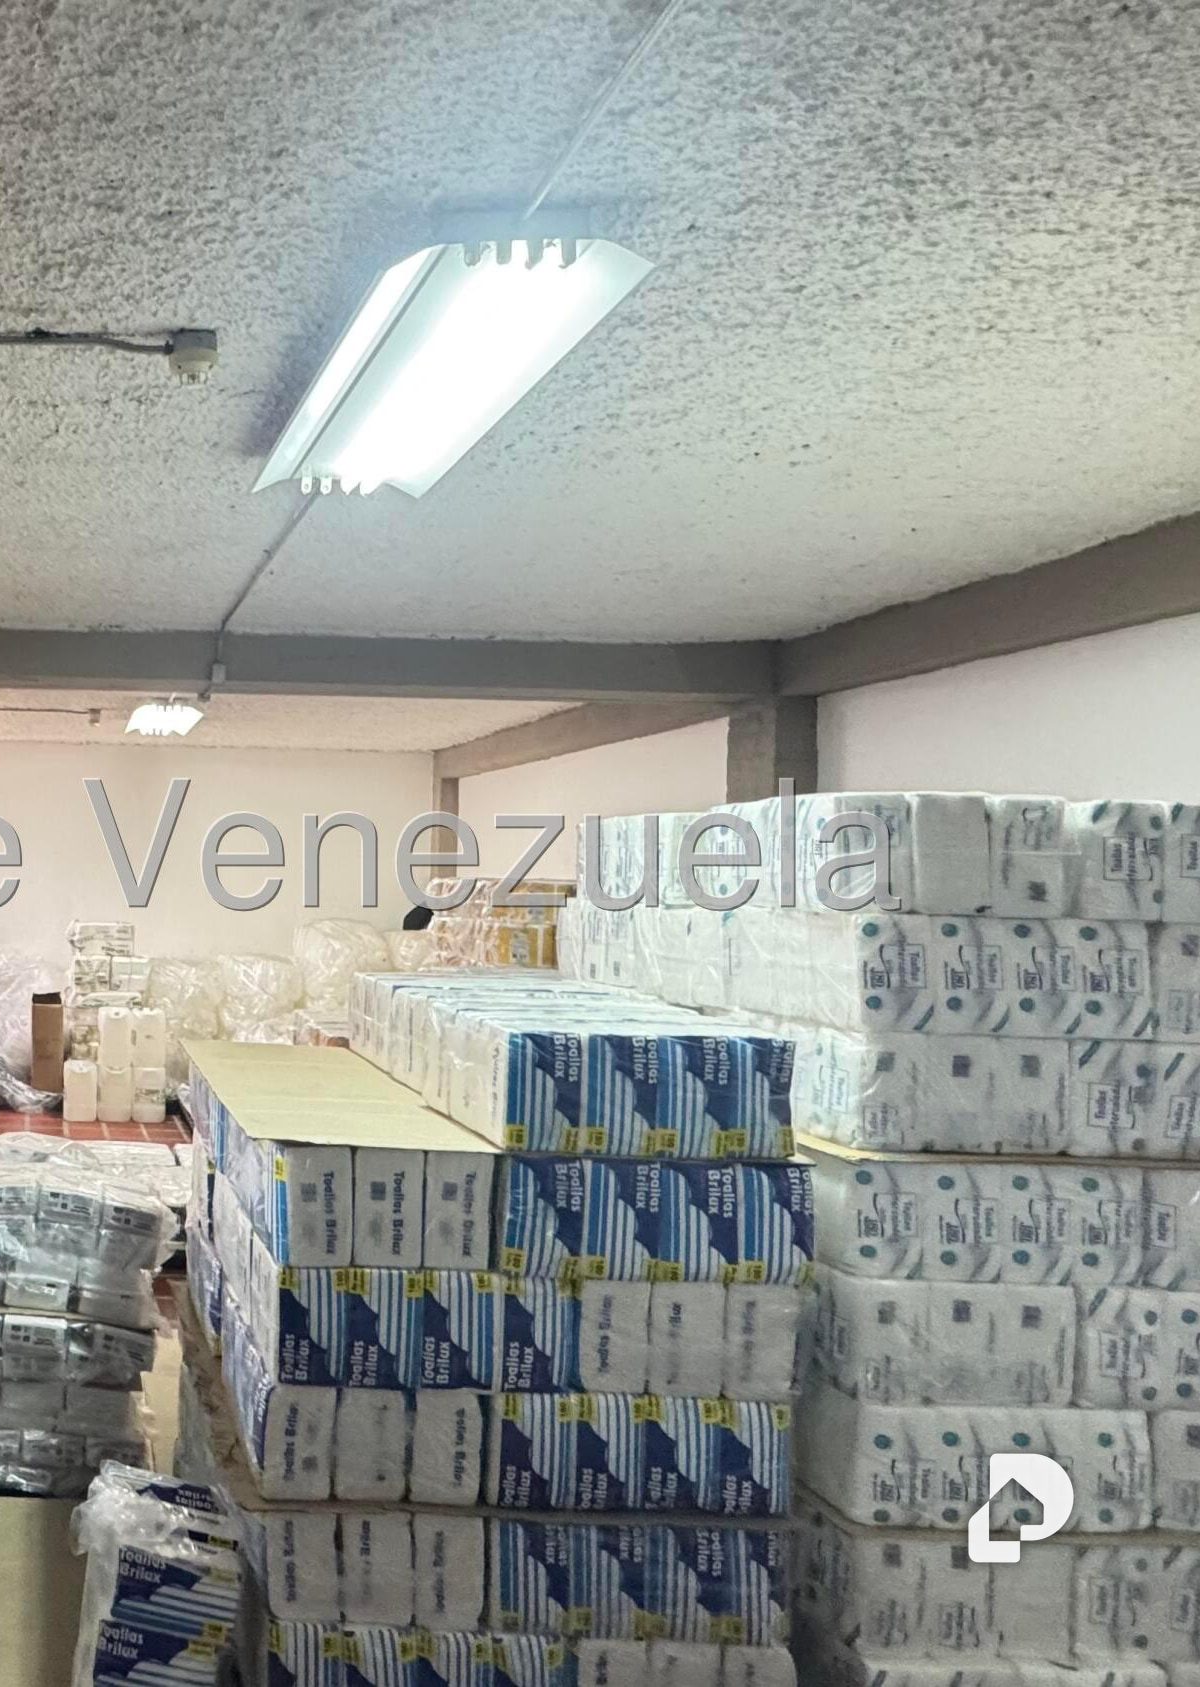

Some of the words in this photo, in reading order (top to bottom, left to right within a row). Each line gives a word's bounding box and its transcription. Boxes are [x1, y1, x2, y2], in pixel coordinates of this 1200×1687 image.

[553, 1034, 566, 1079] Brilux
[567, 1031, 580, 1083] Toallas
[632, 1036, 645, 1081] Brilux
[645, 1035, 659, 1085] Toallas
[702, 1038, 717, 1081] Brilux
[718, 1036, 732, 1086] Toallas
[323, 1170, 335, 1214] Toallas
[393, 1170, 405, 1214] Toallas
[555, 1163, 568, 1209] Brilux
[569, 1160, 583, 1212] Toallas
[637, 1164, 649, 1209] Brilux
[650, 1161, 661, 1213] Toallas
[707, 1169, 720, 1215] Brilux
[721, 1167, 734, 1218] Toallas
[787, 1167, 801, 1212] Brilux
[325, 1219, 337, 1254] Brilux
[392, 1219, 404, 1255] Brilux
[281, 1333, 295, 1381] Toallas
[295, 1339, 310, 1380] Brilux
[350, 1340, 364, 1386] Toallas
[363, 1345, 378, 1386] Brilux
[422, 1336, 436, 1384] Toallas
[436, 1341, 450, 1384] Brilux
[505, 1341, 519, 1390] Toallas
[518, 1346, 534, 1388] Brilux
[175, 1495, 213, 1510] oallas
[502, 1465, 516, 1507] oallas
[580, 1468, 593, 1509] oallas
[645, 1467, 662, 1509] Tallas
[722, 1475, 737, 1515] oallas
[738, 1481, 752, 1514] rilux
[119, 1562, 161, 1583] Brilux
[120, 1547, 167, 1570] Toallas
[711, 1531, 724, 1577] oallas
[97, 1636, 139, 1659] Brilux
